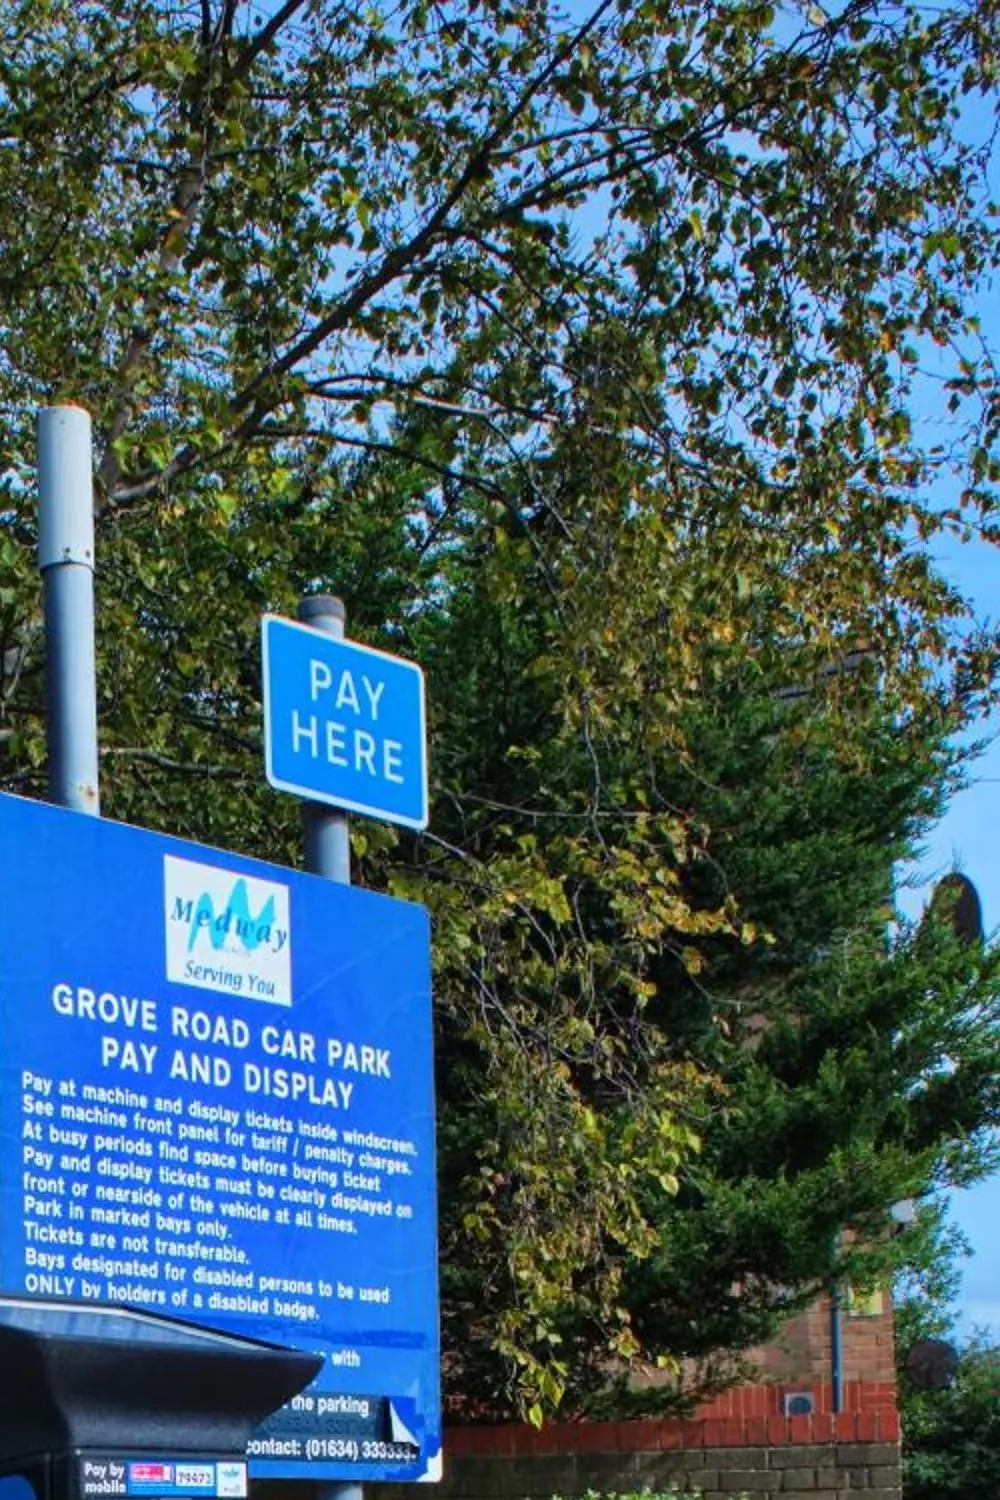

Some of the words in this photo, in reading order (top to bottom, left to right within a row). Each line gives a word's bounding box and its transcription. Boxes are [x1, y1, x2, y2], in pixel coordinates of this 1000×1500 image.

[309, 658, 385, 720] PAY
[291, 709, 404, 784] HERE
[171, 896, 287, 953] Medway
[184, 960, 242, 991] Serving
[248, 973, 275, 997] You
[52, 983, 157, 1031] GROVE
[171, 1006, 249, 1048] ROAD
[261, 1025, 315, 1063] CAR
[327, 1038, 391, 1079] PARK
[101, 1036, 157, 1074] PAY
[170, 1050, 231, 1087] AND
[244, 1062, 353, 1110] DISPLAY
[22, 1071, 52, 1096] Pay
[59, 1079, 76, 1097] at
[83, 1085, 148, 1109] machine
[154, 1097, 182, 1115] and
[188, 1100, 239, 1127] display
[246, 1110, 293, 1133] tickets
[299, 1120, 337, 1142] inside
[343, 1129, 418, 1156] windscreen.
[23, 1093, 53, 1116] See
[61, 1103, 127, 1128] machine
[134, 1113, 172, 1136] front
[179, 1122, 219, 1142] panel
[225, 1128, 245, 1147] for
[252, 1132, 288, 1153] tariff
[293, 1138, 299, 1156] /
[305, 1144, 354, 1167] penalty
[359, 1153, 412, 1176] charges.
[23, 1119, 42, 1141] At
[49, 1124, 88, 1149] busy
[95, 1135, 152, 1156] periods
[159, 1142, 188, 1162] find
[195, 1151, 236, 1168] space
[242, 1154, 287, 1176] before
[293, 1163, 338, 1187] buying
[343, 1172, 381, 1192] ticket
[23, 1146, 52, 1170] Pay
[60, 1155, 90, 1173] and
[97, 1159, 152, 1183] display
[159, 1166, 210, 1190] tickets
[216, 1177, 252, 1195] must
[257, 1181, 274, 1198] be
[280, 1185, 326, 1208] clearly
[332, 1193, 392, 1216] displayed
[396, 1205, 412, 1219] on
[23, 1171, 65, 1194] front
[72, 1182, 89, 1197] or
[96, 1185, 162, 1207] nearside
[168, 1192, 184, 1208] of
[190, 1195, 214, 1213] the
[220, 1201, 269, 1221] vehicle
[275, 1209, 289, 1224] at
[296, 1210, 312, 1228] all
[318, 1214, 357, 1235] times.
[24, 1195, 62, 1218] Park
[69, 1201, 84, 1220] in
[91, 1207, 149, 1227] marked
[156, 1213, 190, 1235] bays
[197, 1220, 232, 1240] only.
[24, 1221, 84, 1246] Tickets
[90, 1232, 116, 1249] are
[123, 1236, 149, 1253] not
[155, 1238, 250, 1264] transferable.
[25, 1247, 65, 1270] Bays
[72, 1254, 158, 1278] designated
[165, 1263, 186, 1281] for
[193, 1266, 253, 1288] disabled
[259, 1275, 314, 1295] persons
[318, 1280, 333, 1297] to
[338, 1282, 354, 1300] be
[359, 1287, 390, 1304] used
[25, 1273, 75, 1295] ONLY
[81, 1279, 100, 1299] by
[107, 1281, 166, 1305] holders
[171, 1289, 187, 1306] of
[193, 1294, 203, 1308] a
[208, 1292, 268, 1314] disabled
[274, 1299, 320, 1321] badge.
[331, 1350, 361, 1367] with
[292, 1396, 313, 1411] the
[317, 1396, 369, 1418] parking
[84, 1461, 106, 1478] Pay
[109, 1461, 125, 1478] by
[305, 1439, 358, 1462] (01634)
[84, 1480, 126, 1494] mobile
